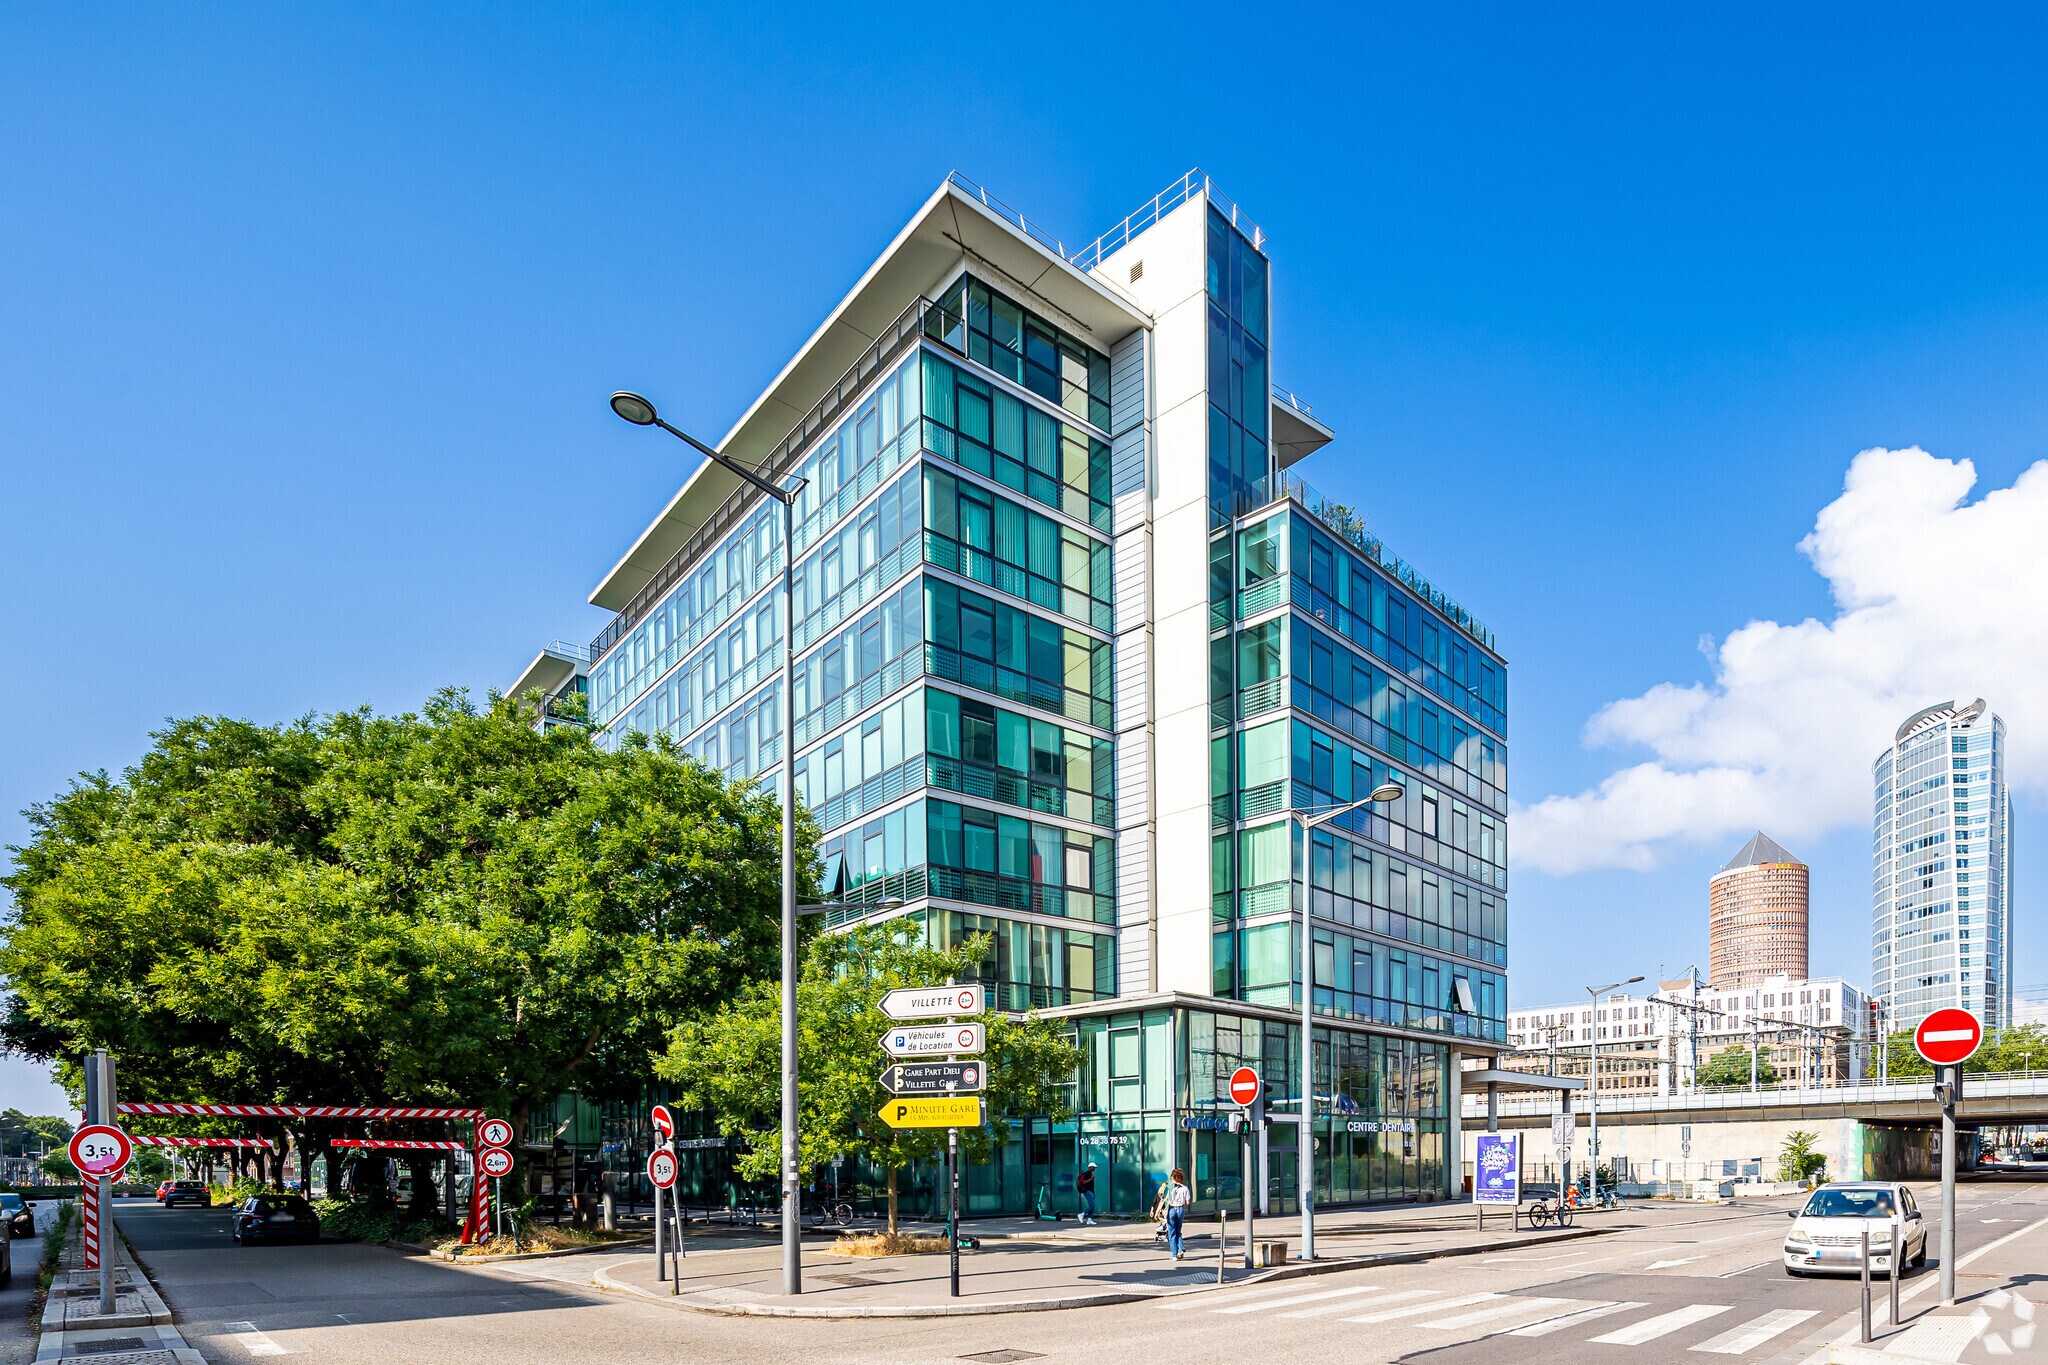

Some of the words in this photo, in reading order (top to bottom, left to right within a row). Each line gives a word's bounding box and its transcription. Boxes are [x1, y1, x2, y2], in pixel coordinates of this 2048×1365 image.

[911, 997, 953, 1007] VILLETTE
[908, 1031, 946, 1040] Véhicules
[908, 1042, 917, 1051] de
[920, 1041, 953, 1050] Location
[905, 1069, 923, 1077] GARE
[924, 1068, 942, 1076] PART
[943, 1067, 960, 1075] DIEU
[905, 1080, 936, 1088] VILLETTE
[910, 1105, 947, 1114] MINUTE
[950, 1104, 976, 1113] GARE
[1347, 1121, 1378, 1132] CENTRE
[1110, 1136, 1118, 1144] 75
[1119, 1136, 1128, 1144] 19
[85, 1144, 115, 1159] 3,5t
[487, 1158, 507, 1167] 2,6m
[656, 1164, 672, 1176] 3,5t
